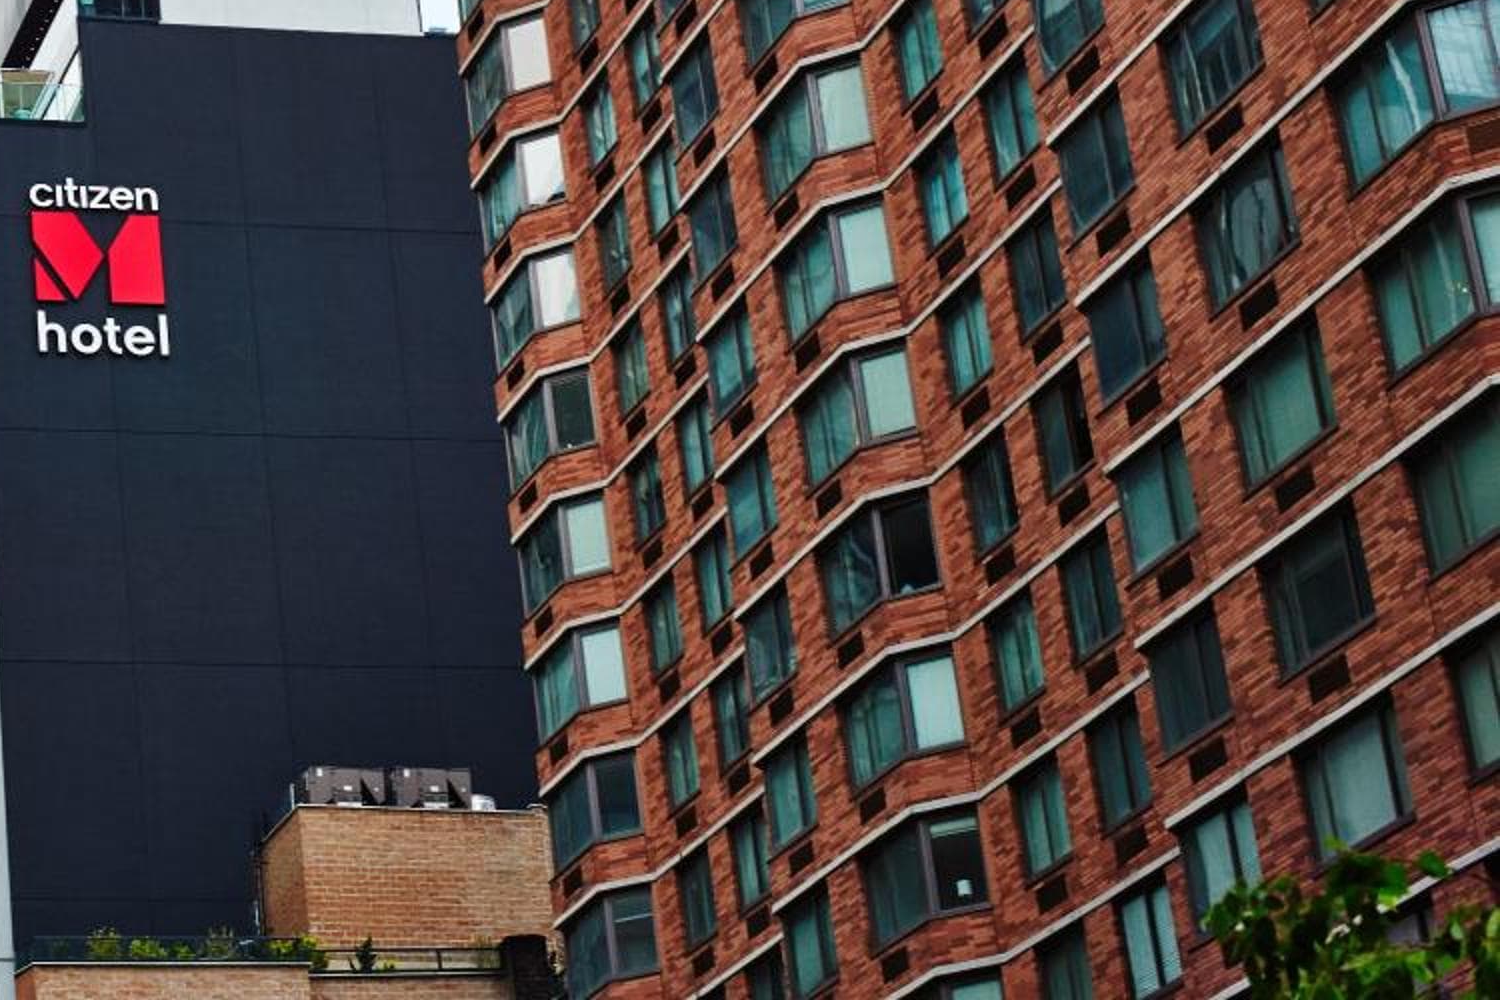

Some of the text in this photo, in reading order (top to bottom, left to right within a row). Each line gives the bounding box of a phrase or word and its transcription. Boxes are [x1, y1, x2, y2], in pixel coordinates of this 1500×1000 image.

[29, 177, 159, 211] citizen
[30, 211, 165, 305] M
[36, 309, 170, 356] hotel
